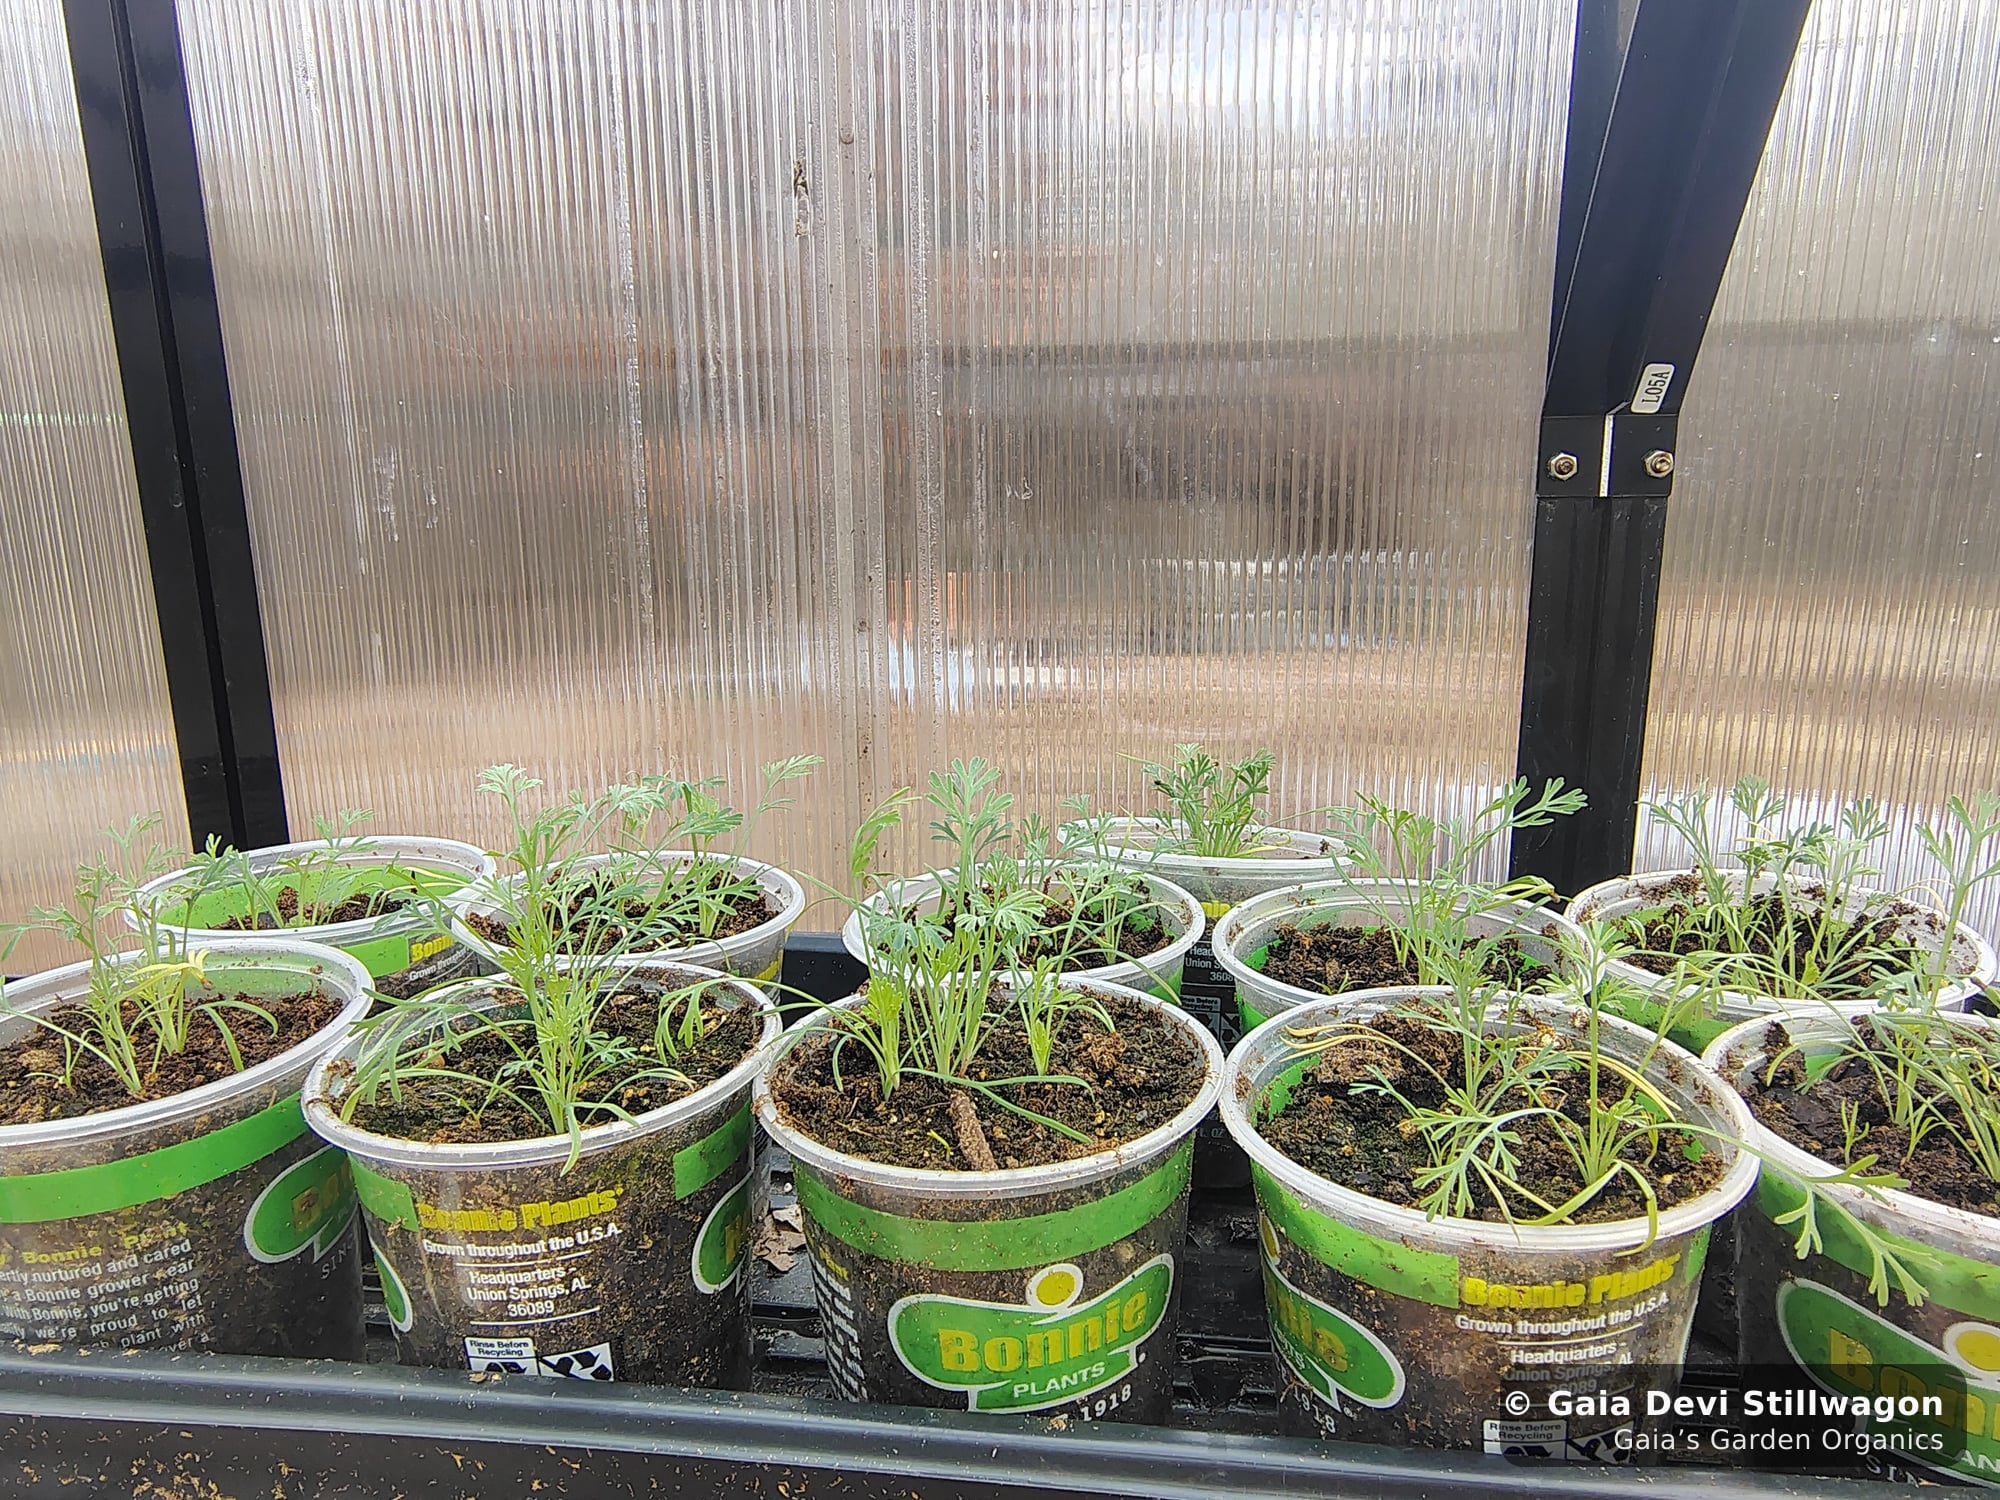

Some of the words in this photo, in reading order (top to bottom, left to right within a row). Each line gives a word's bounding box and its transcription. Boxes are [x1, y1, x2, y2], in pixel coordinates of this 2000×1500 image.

[1185, 957, 1211, 968] Union
[1210, 971, 1233, 982] 3608
[22, 1246, 102, 1264] Bonnie
[32, 1262, 102, 1282] nurtured
[106, 1254, 139, 1274] and
[143, 1238, 192, 1264] cared
[422, 1239, 466, 1256] Grown
[467, 1241, 548, 1259] throughout
[549, 1236, 575, 1251] the
[25, 1286, 80, 1302] Bonnie
[87, 1272, 150, 1299] grower
[154, 1258, 195, 1280] ear
[466, 1286, 508, 1301] Union
[509, 1282, 570, 1302] Springs,
[571, 1275, 592, 1292] AL
[469, 1265, 567, 1286] Headquarters
[90, 1297, 140, 1317] you're
[143, 1278, 199, 1306] getting
[1462, 1277, 1586, 1308] Bonnie
[35, 1326, 77, 1338] we're
[90, 1314, 138, 1337] proud
[151, 1308, 168, 1320] to
[181, 1294, 202, 1311] let
[507, 1301, 555, 1318] 36089
[1455, 1314, 1513, 1334] Grown
[1516, 1314, 1607, 1336] throughout
[1609, 1308, 1632, 1324] the
[121, 1327, 162, 1348] plant
[171, 1312, 206, 1333] with
[937, 1291, 1148, 1372] Bonnie
[469, 1340, 495, 1348] Rinse
[478, 1348, 524, 1356] Recycling
[1511, 1345, 1617, 1365] Headquarters
[1013, 1361, 1106, 1399] PLANTS
[1503, 1367, 1550, 1382] Union
[1619, 1351, 1634, 1366] AL
[1080, 1384, 1132, 1422] 1918
[1489, 1422, 1521, 1431] Rinse
[1525, 1422, 1561, 1431] Before
[1499, 1431, 1553, 1440] Recycling
